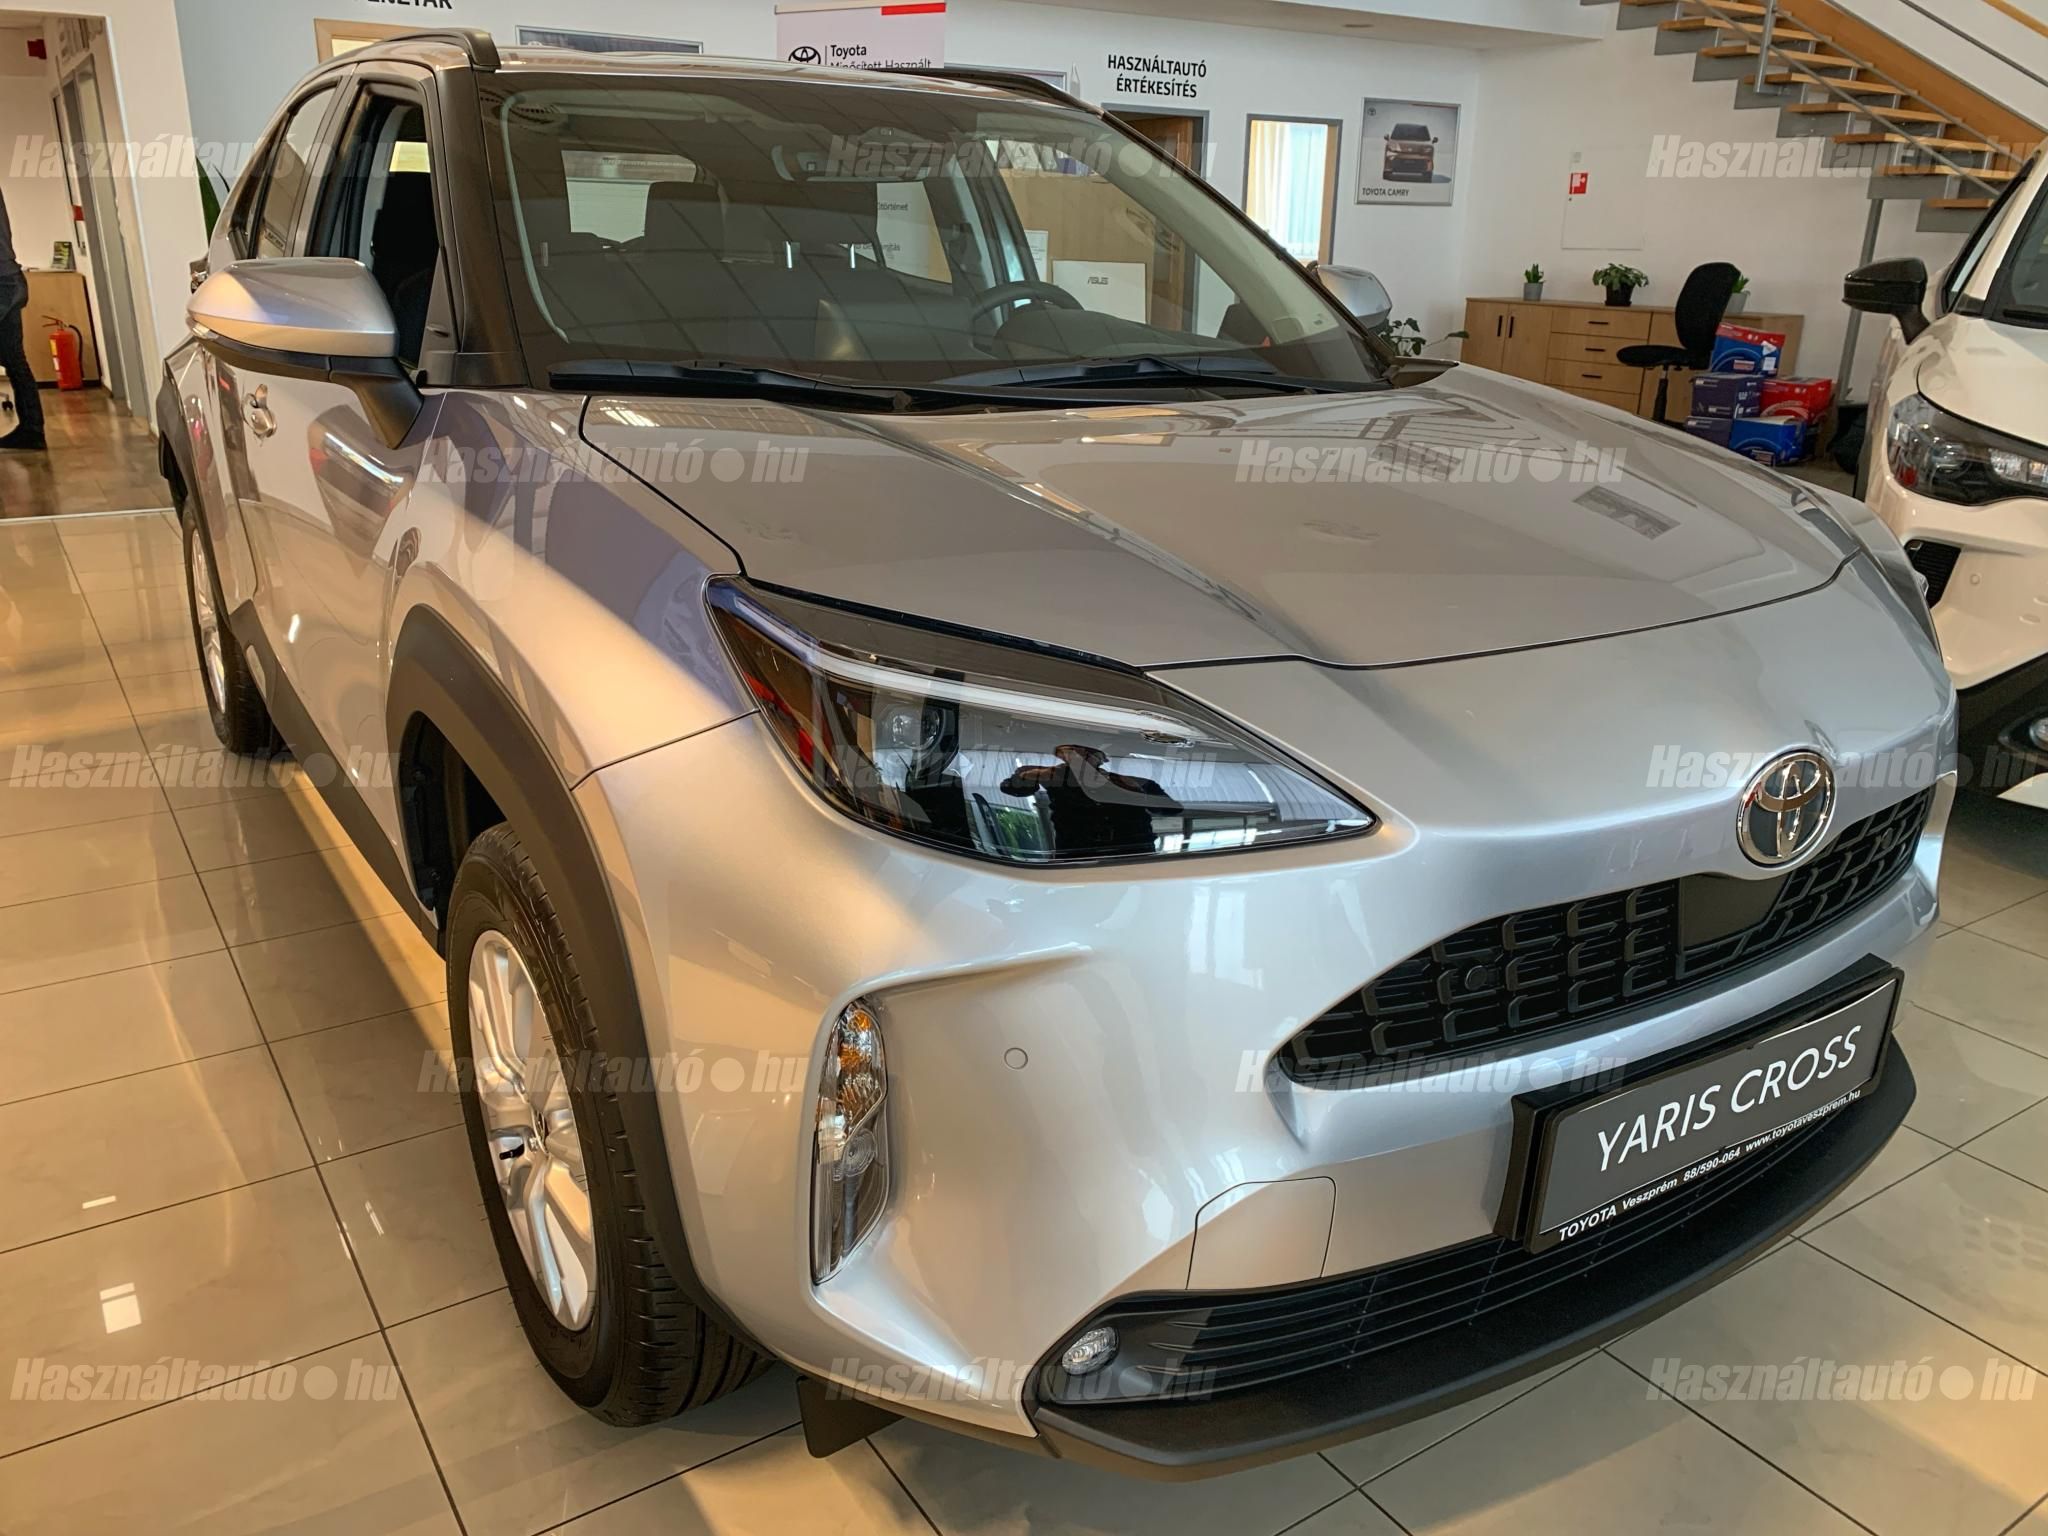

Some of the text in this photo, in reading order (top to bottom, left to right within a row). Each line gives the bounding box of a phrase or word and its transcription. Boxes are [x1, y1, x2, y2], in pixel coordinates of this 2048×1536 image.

[830, 44, 867, 60] Toyota
[885, 58, 931, 69] Használt
[1108, 54, 1207, 78] HASZNÁLTAUTÓ
[1116, 73, 1197, 98] ÉRTÉKESÍTÉS
[1362, 187, 1410, 197] TOYOTA CAMRY
[1087, 276, 1109, 285] ASUS
[1597, 1024, 1862, 1172] YARIS CROSS
[1559, 1088, 1861, 1242] TOYOTA Veszprém 88/590-064 www.toyotaveszprem.hu
